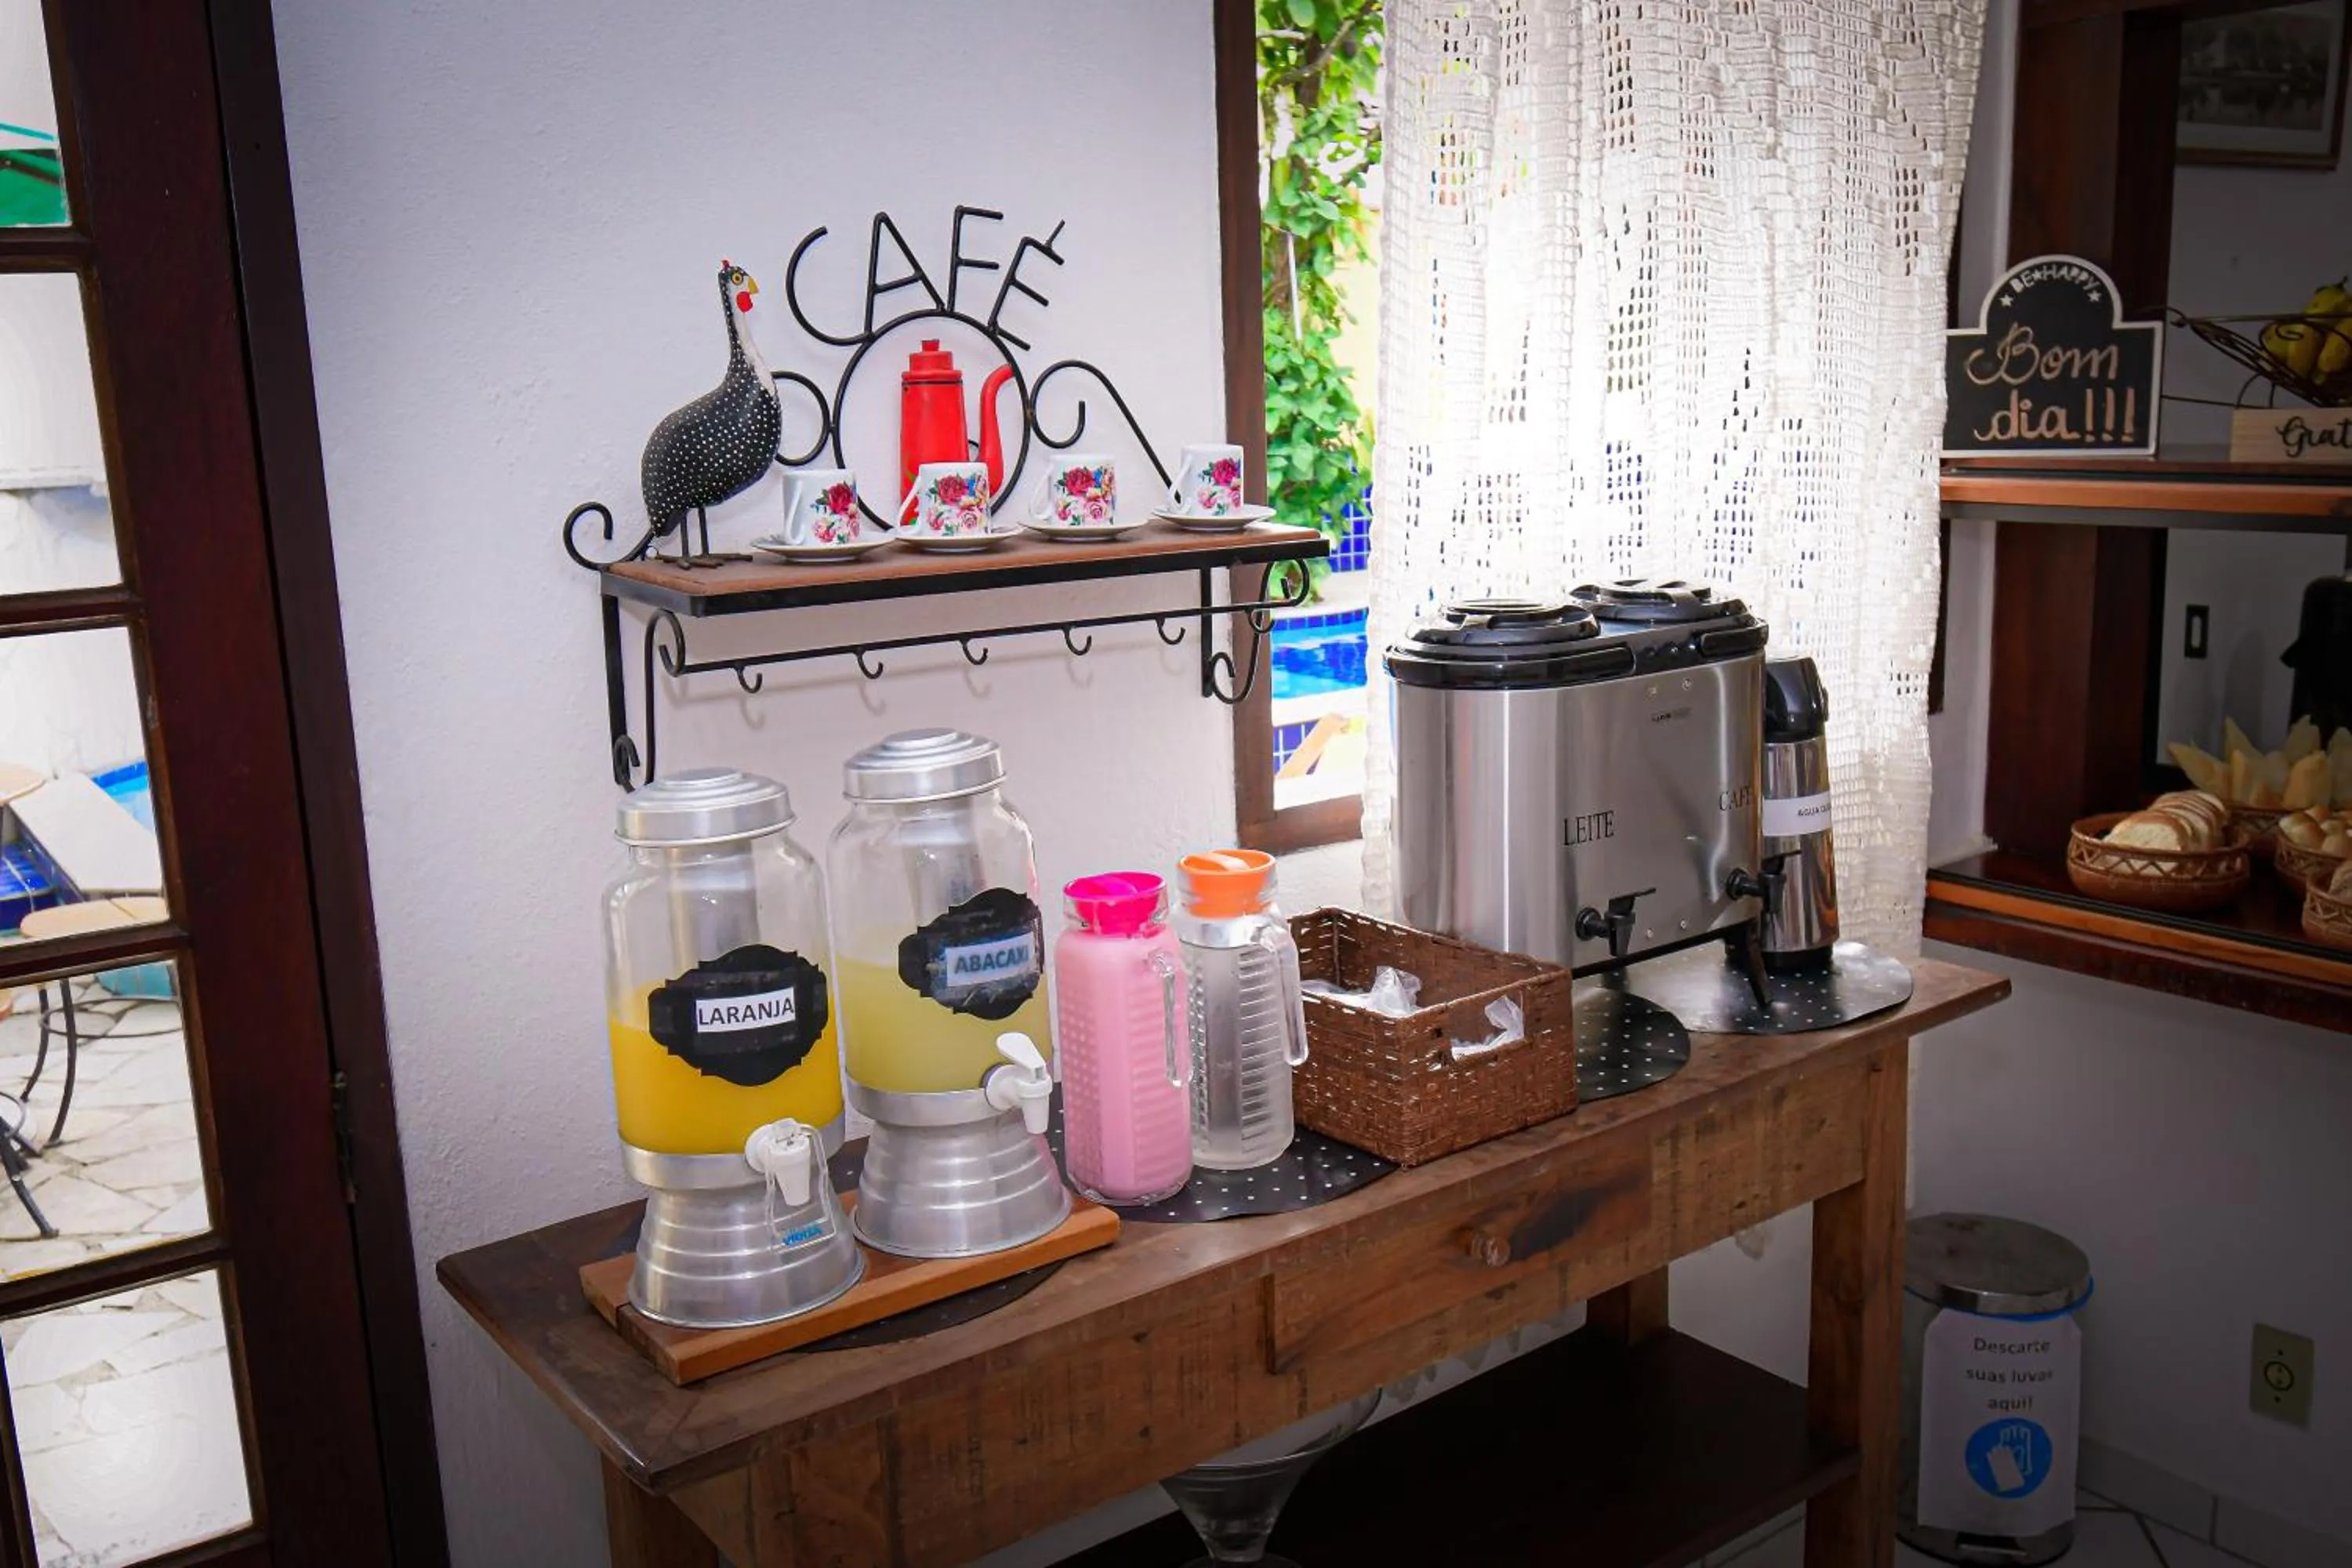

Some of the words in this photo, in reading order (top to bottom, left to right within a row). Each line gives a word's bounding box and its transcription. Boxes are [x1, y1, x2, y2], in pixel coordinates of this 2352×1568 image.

[2009, 270, 2034, 292] BE
[2042, 264, 2100, 290] HAPPY
[1965, 322, 2117, 385] Bom
[1974, 389, 2135, 442] dia!!!
[1564, 810, 1613, 845] LEITE
[954, 945, 1029, 974] ABACAXI
[699, 996, 794, 1025] LARANJA
[1973, 1337, 2050, 1354] Descarte
[1965, 1369, 2005, 1383] suas
[1987, 1396, 2032, 1412] aqui!
